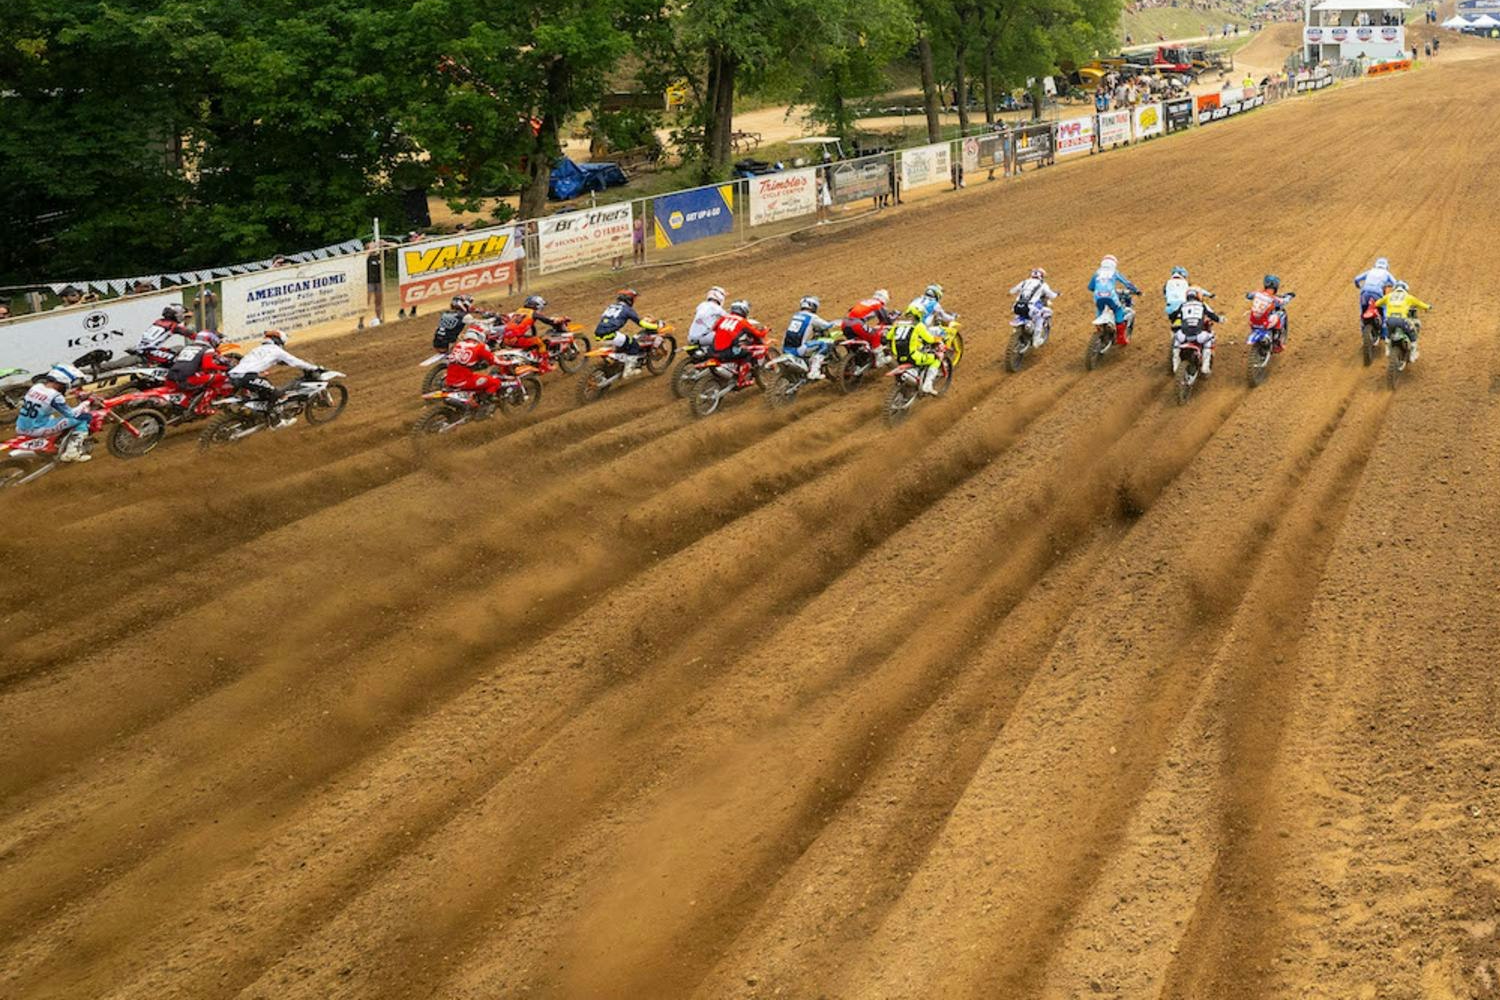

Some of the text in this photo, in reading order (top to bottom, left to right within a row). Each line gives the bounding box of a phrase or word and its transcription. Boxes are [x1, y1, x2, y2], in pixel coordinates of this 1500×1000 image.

[404, 234, 510, 276] VAITH
[246, 273, 346, 303] AMERICAN HOME
[404, 266, 512, 303] GASGAS
[67, 329, 125, 348] ICON
